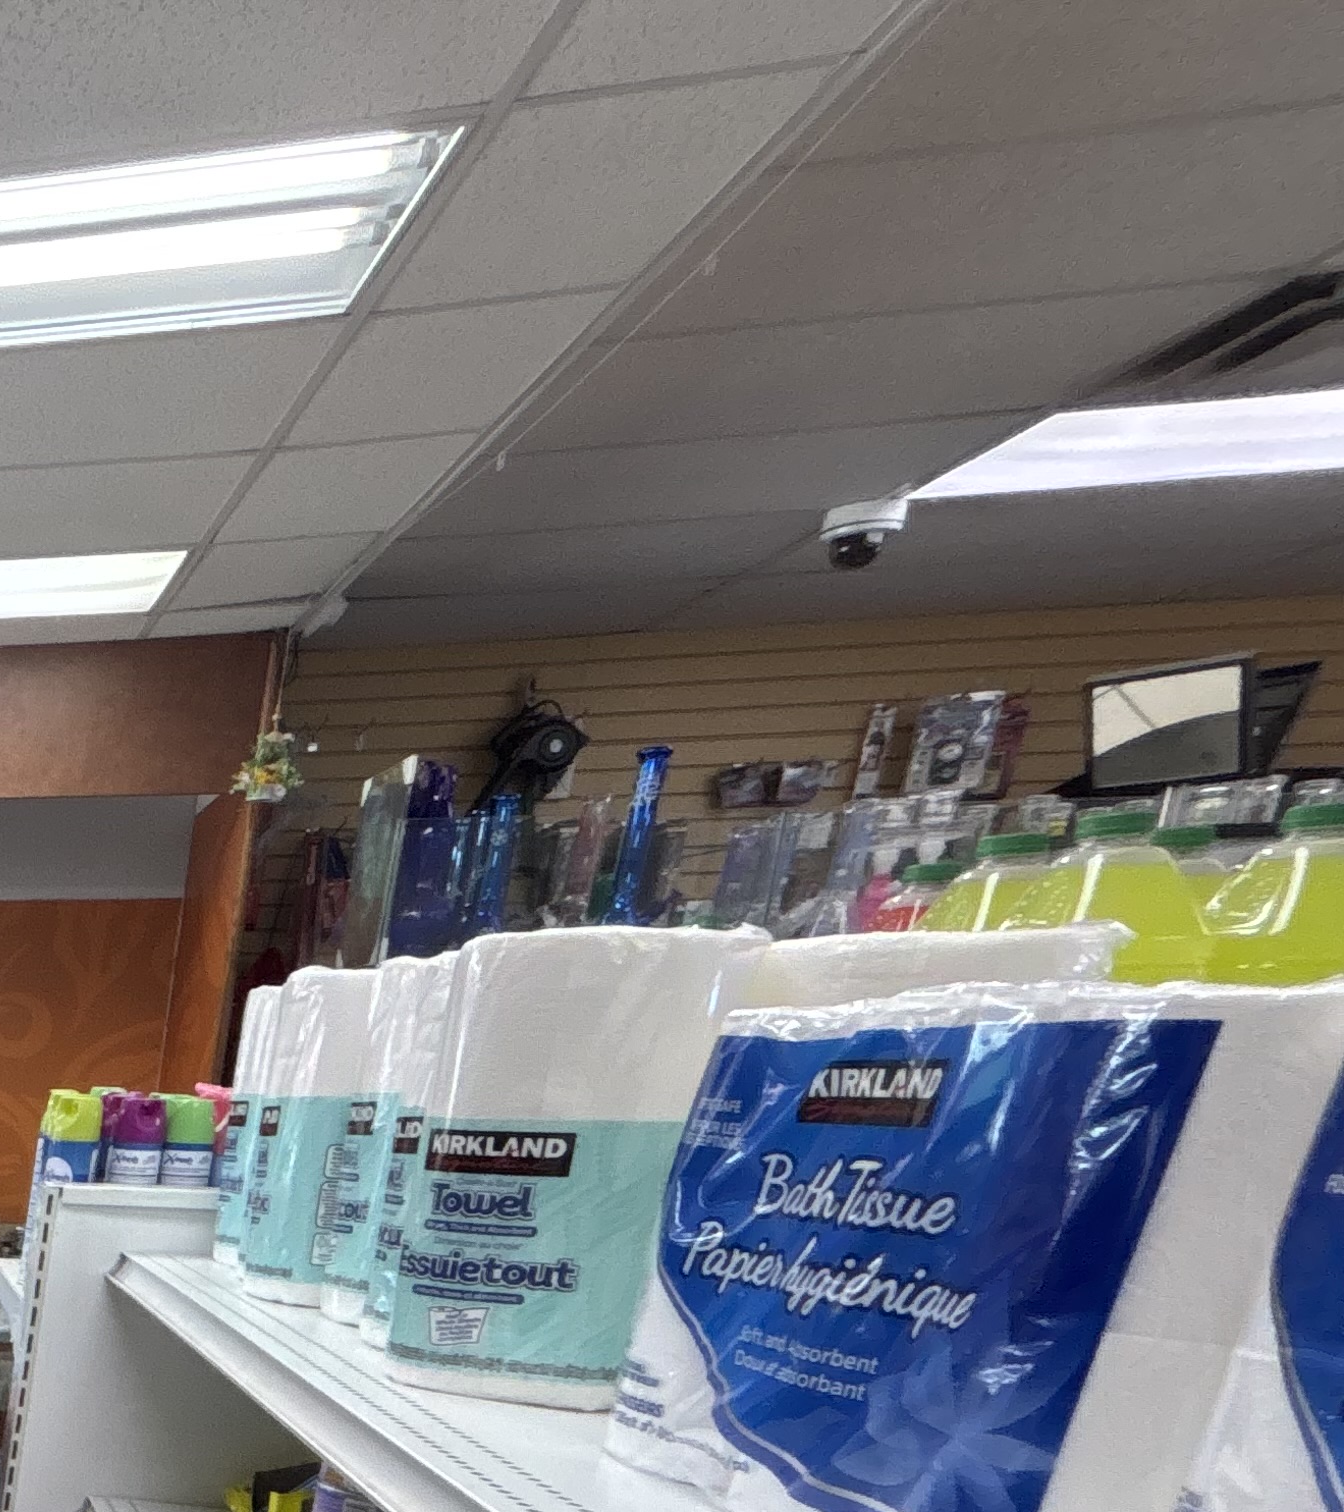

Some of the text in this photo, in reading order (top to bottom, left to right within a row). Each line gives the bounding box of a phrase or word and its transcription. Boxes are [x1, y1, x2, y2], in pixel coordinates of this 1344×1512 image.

[807, 1066, 943, 1100] KIRKLAND
[431, 1134, 568, 1159] KIRKLAND
[430, 1182, 535, 1219] Towel
[753, 1153, 957, 1235] Bath Tissue
[682, 1220, 978, 1340] Papier hygiénique
